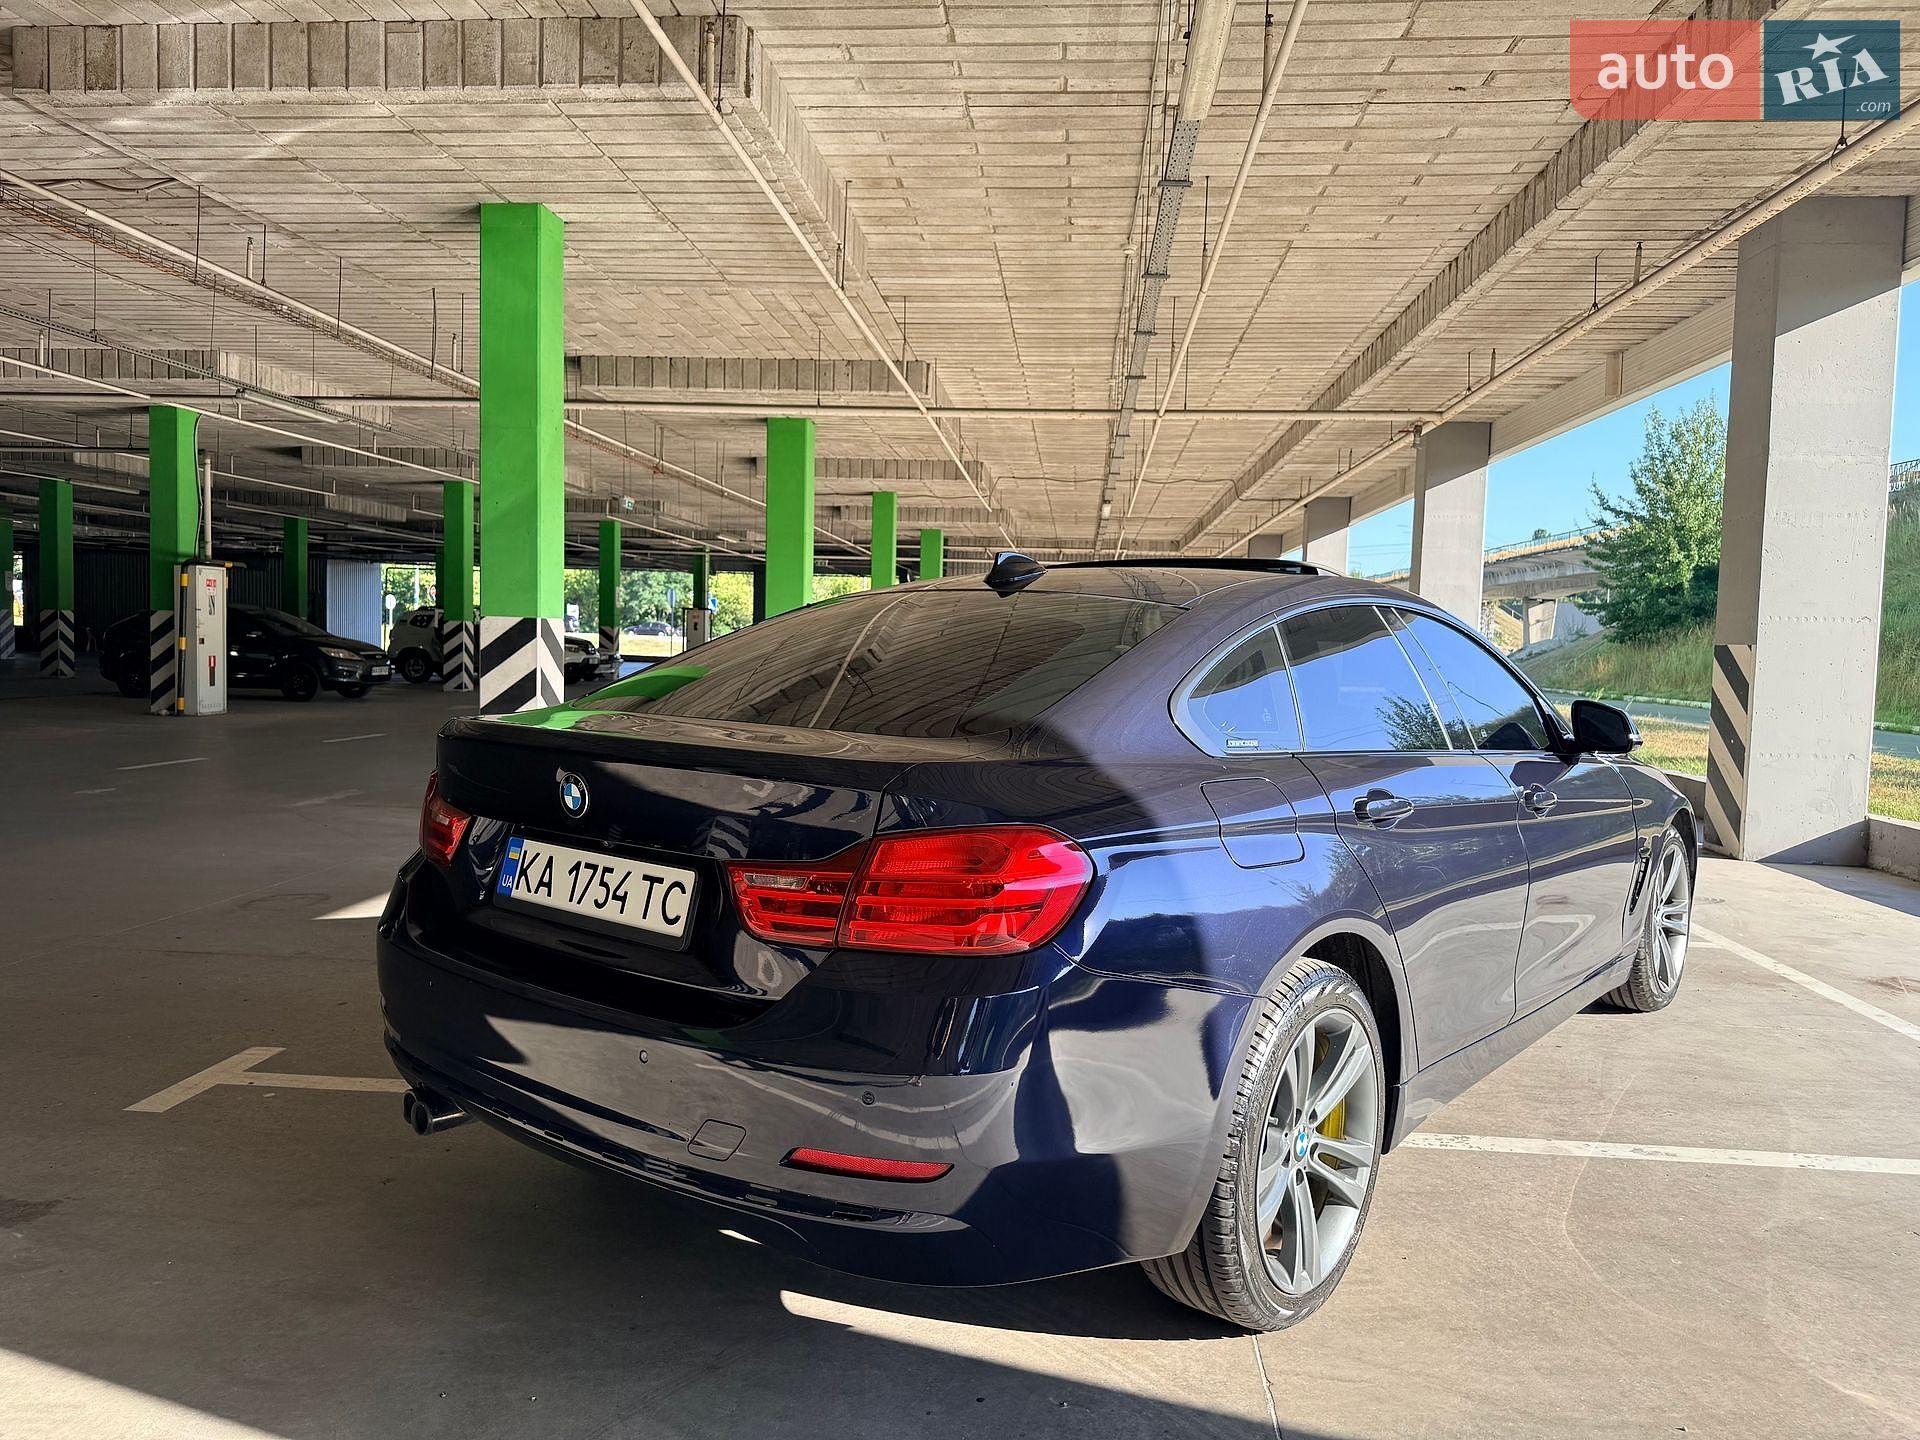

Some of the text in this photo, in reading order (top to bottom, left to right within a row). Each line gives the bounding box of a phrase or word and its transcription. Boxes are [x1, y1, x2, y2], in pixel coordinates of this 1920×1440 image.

[502, 874, 513, 887] UA
[515, 850, 687, 926] KA 1754 TC
